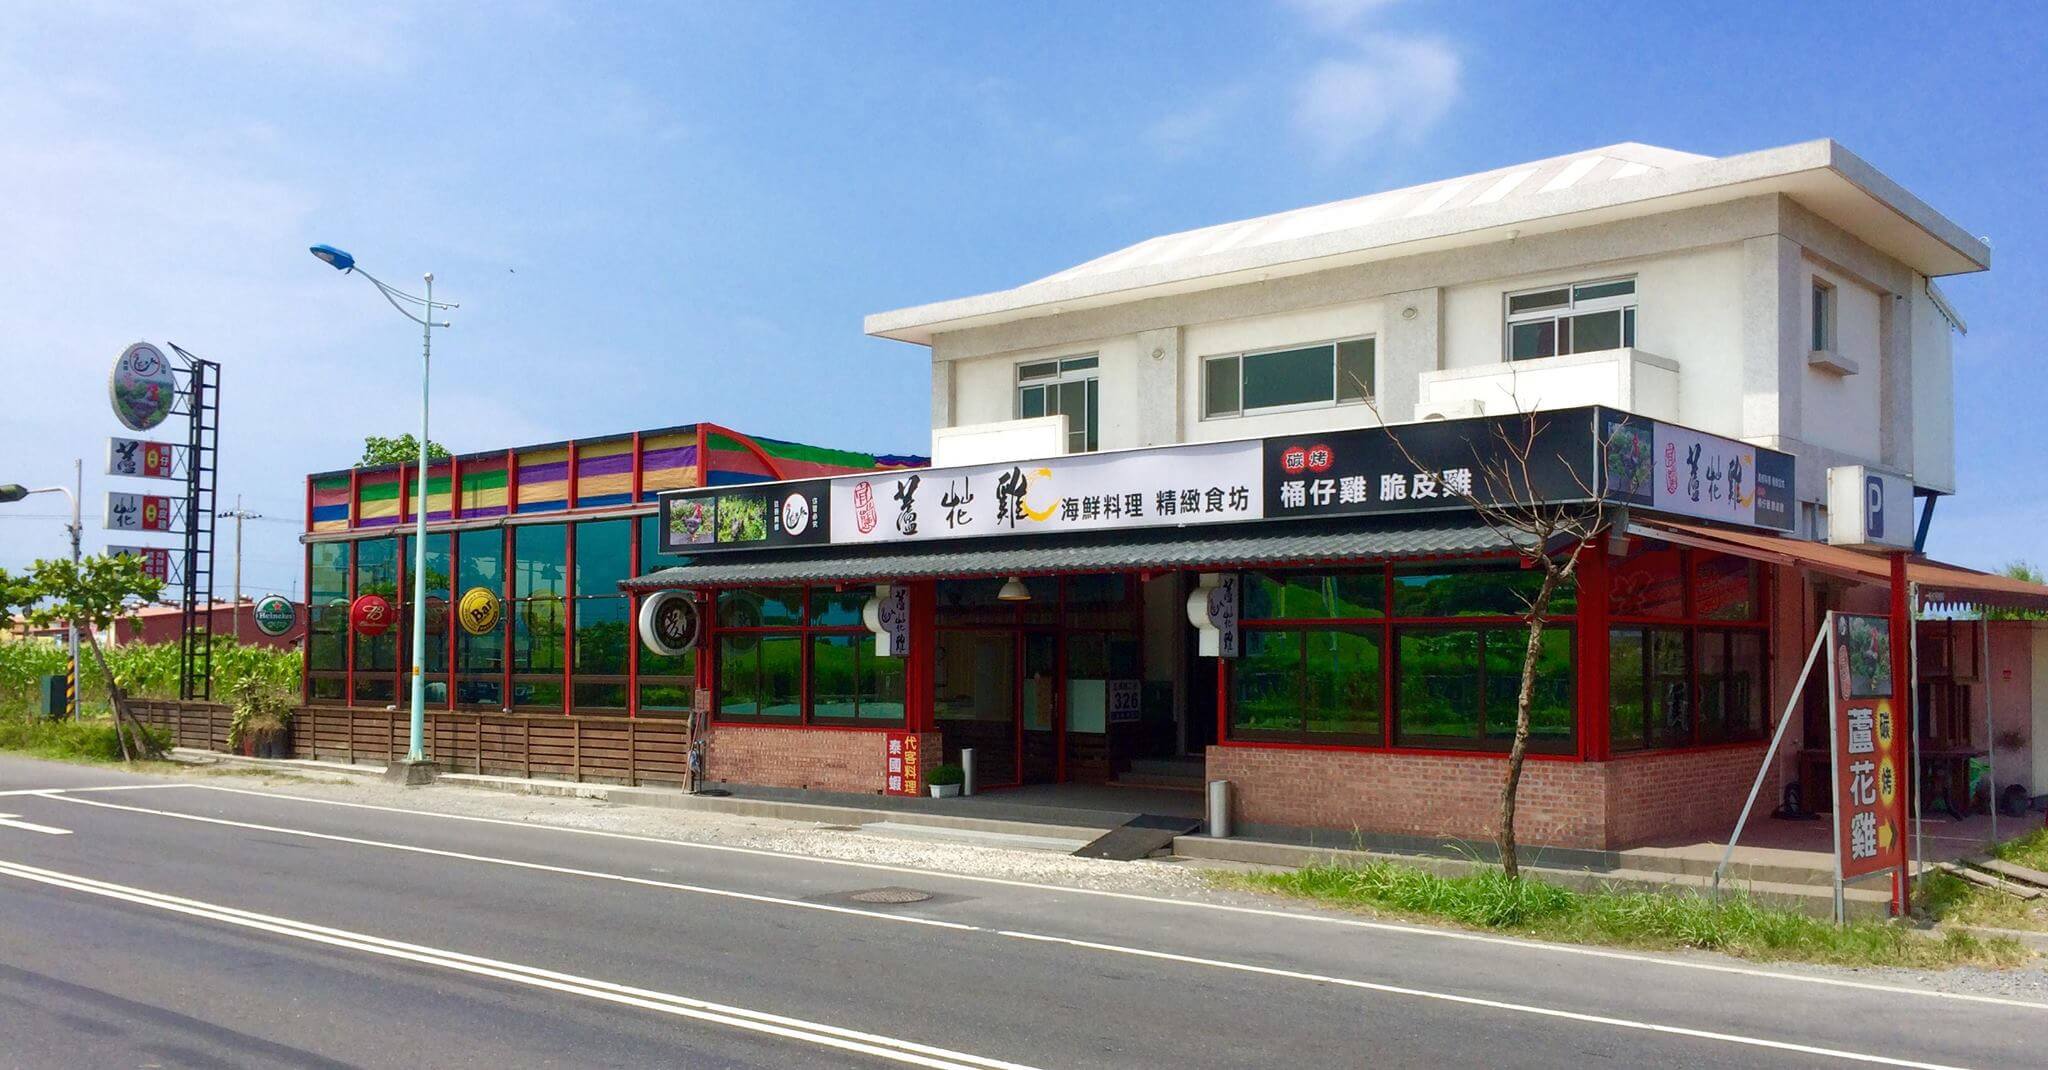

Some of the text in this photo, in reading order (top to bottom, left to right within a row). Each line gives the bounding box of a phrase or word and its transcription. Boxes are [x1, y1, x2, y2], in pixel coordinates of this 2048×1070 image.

[1286, 451, 1328, 468] 碳烤
[1061, 486, 1249, 521] 海鮮料理 精緻食坊
[1280, 468, 1473, 508] 桶仔雞 脆皮雞
[1868, 482, 1882, 530] P
[470, 600, 492, 623] Bar
[1115, 692, 1138, 709] 326
[888, 739, 902, 791] 泰國蝦
[904, 735, 917, 793] 代客料理
[1847, 707, 1877, 861] 蘆花雞
